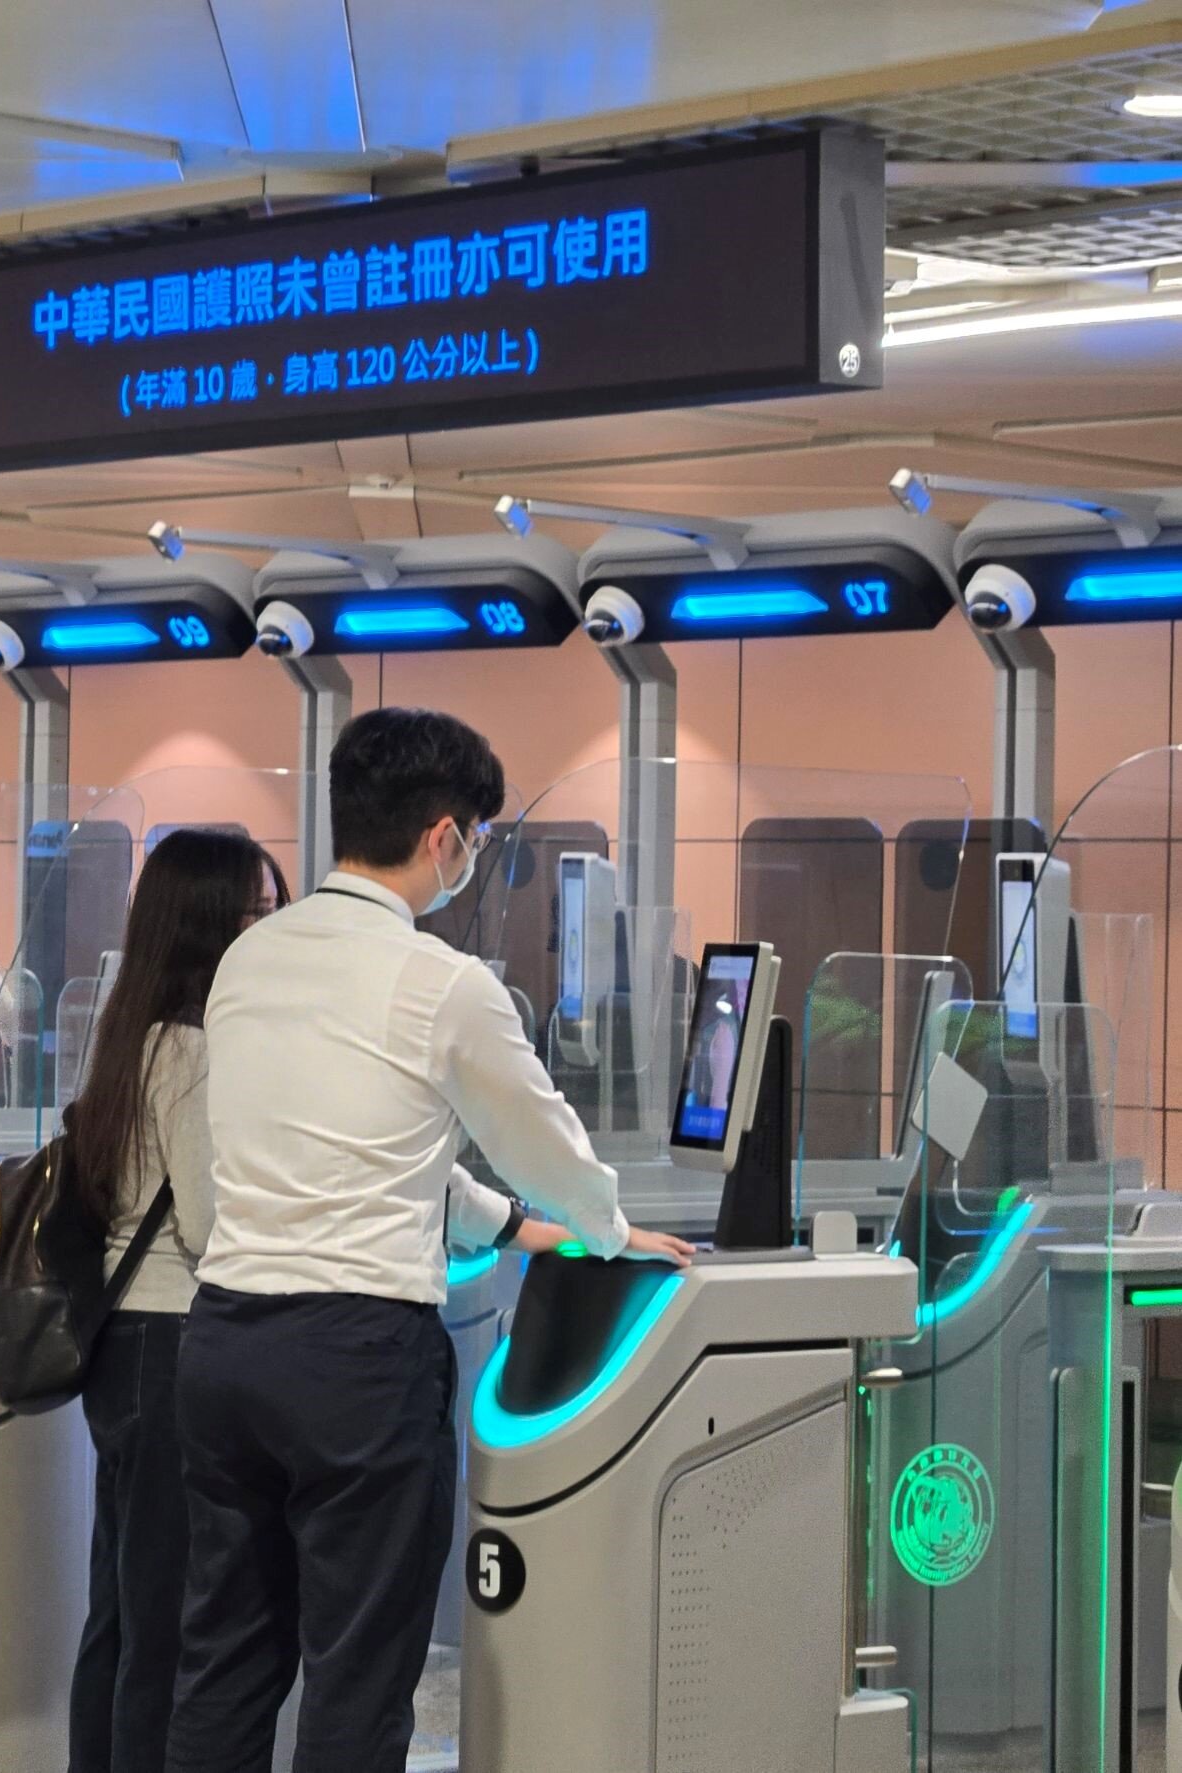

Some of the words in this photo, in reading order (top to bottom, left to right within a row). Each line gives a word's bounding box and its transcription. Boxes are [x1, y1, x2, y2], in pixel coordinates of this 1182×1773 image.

[34, 209, 647, 349] 中華民國護照未曾註冊亦可使用
[194, 366, 225, 403] 10
[346, 346, 396, 386] 120
[402, 328, 539, 381] 公分以上)
[479, 600, 525, 635] 08
[843, 580, 888, 616] 07
[168, 615, 210, 648] 09
[478, 1543, 501, 1598] 5
